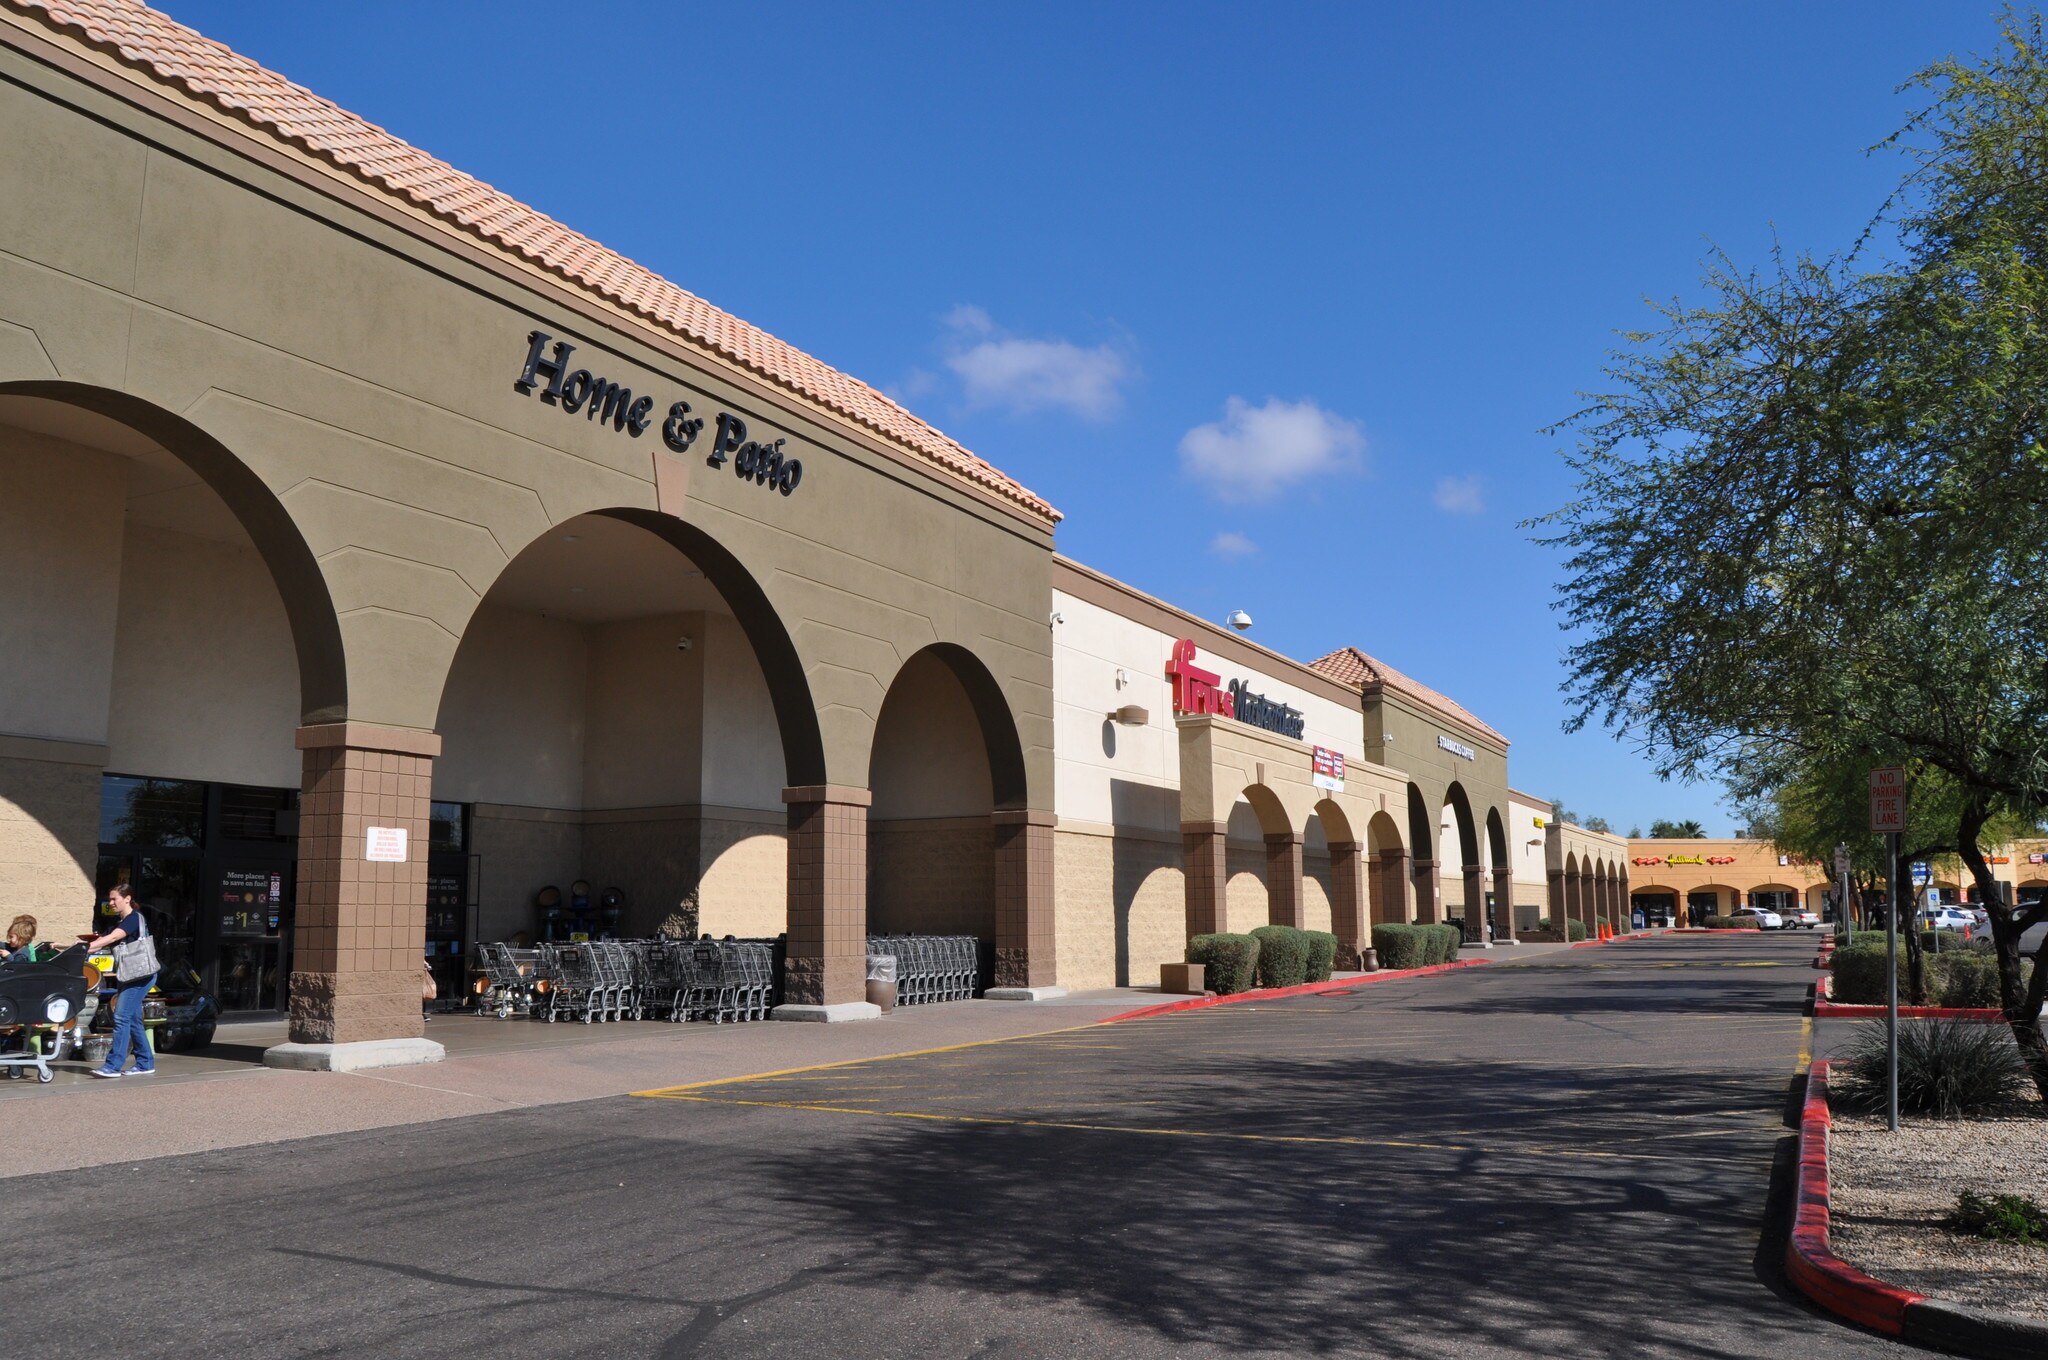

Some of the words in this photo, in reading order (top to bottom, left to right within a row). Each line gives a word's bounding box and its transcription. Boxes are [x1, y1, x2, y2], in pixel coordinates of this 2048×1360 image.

[514, 330, 653, 437] Home
[662, 401, 704, 452] &
[707, 412, 803, 496] Patio
[1879, 773, 1894, 784] NO
[1872, 785, 1902, 798] PARKING
[1877, 800, 1897, 811] FIRE
[1875, 813, 1899, 825] LANE
[1665, 854, 1706, 869] Hallmark
[245, 873, 265, 881] places
